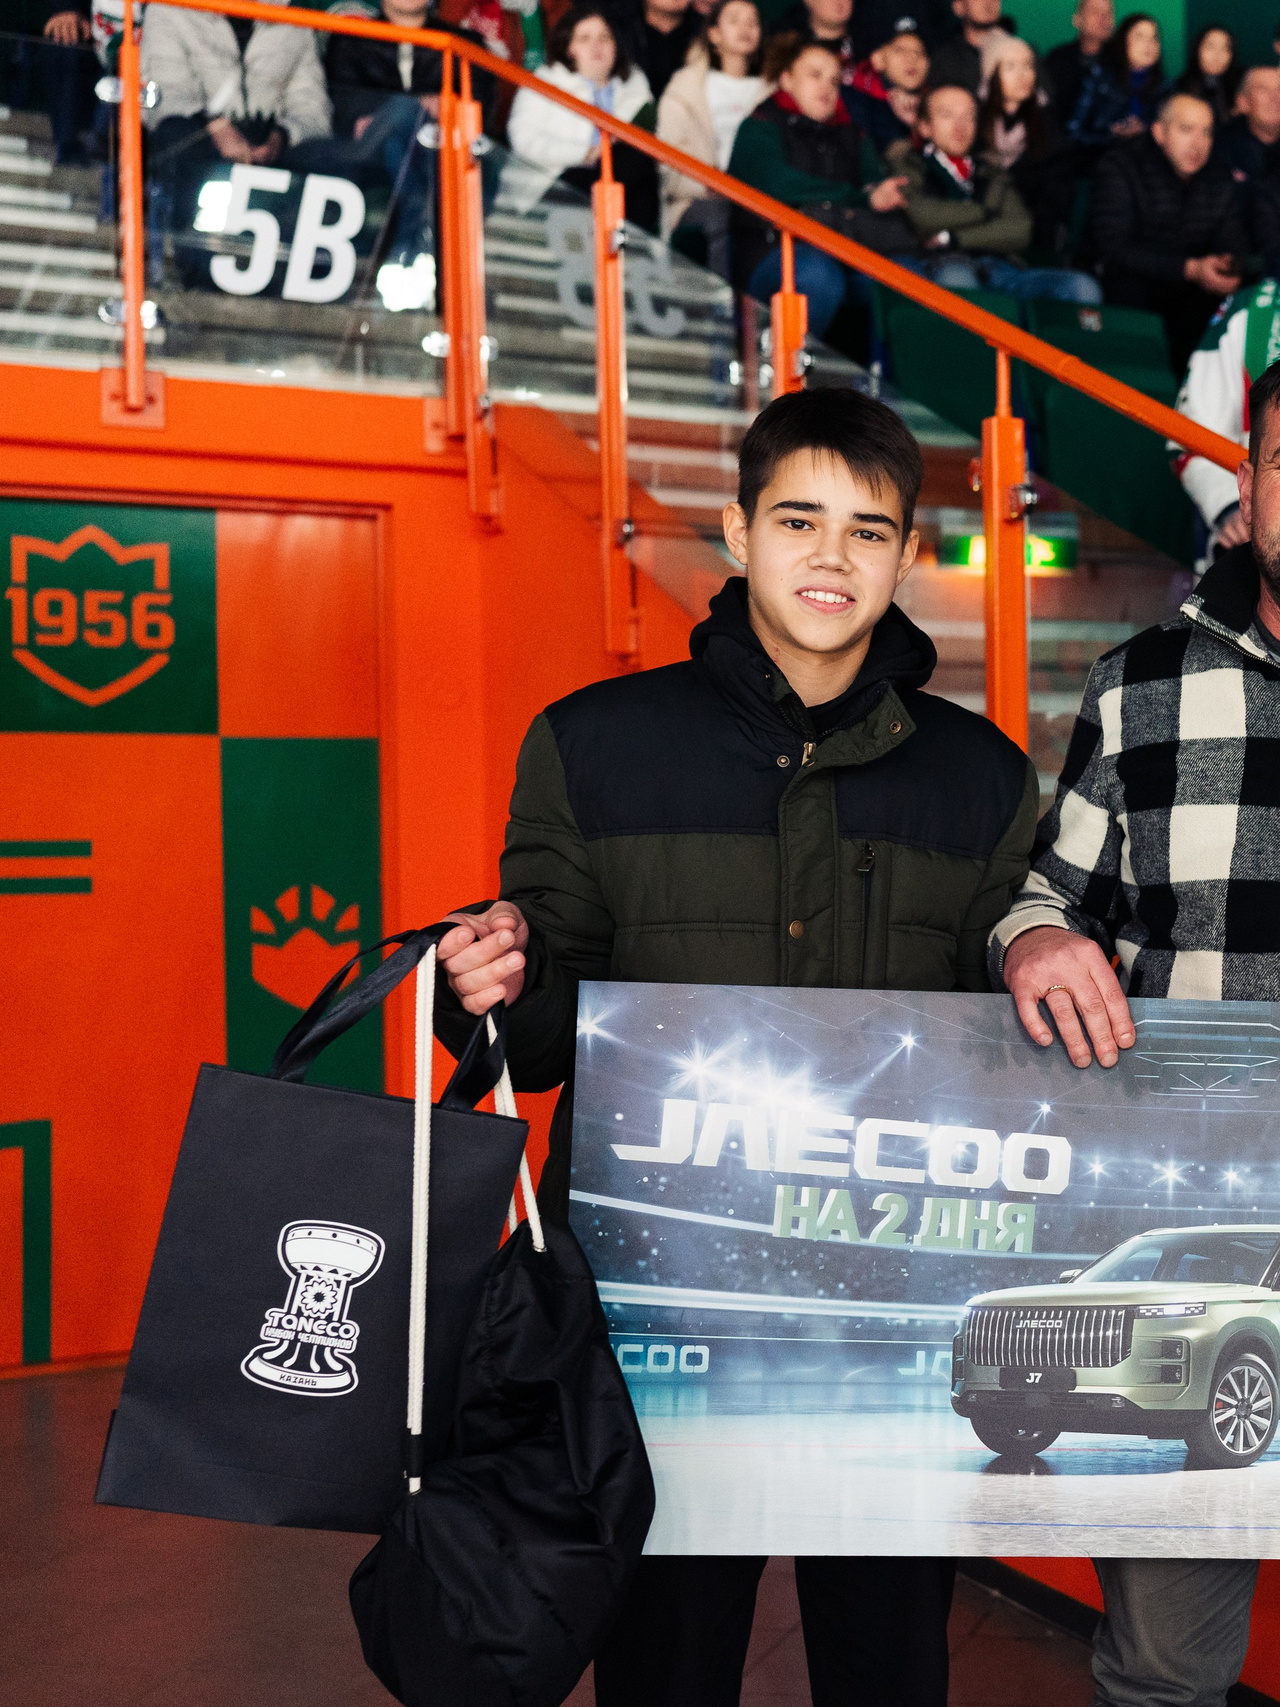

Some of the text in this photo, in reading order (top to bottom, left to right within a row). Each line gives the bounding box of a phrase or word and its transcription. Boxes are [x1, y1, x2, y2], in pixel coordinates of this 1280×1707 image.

[210, 163, 366, 303] 5B
[4, 586, 175, 650] 1956
[610, 1098, 1072, 1196] JAECOO
[772, 1184, 1037, 1254] НА 2 ДНЯ
[264, 1326, 353, 1350] КУБОК ЧЕМПИОНОВ
[1015, 1319, 1063, 1328] JAECOO
[279, 1373, 318, 1387] КАЗАНЬ
[1026, 1373, 1042, 1384] J7
